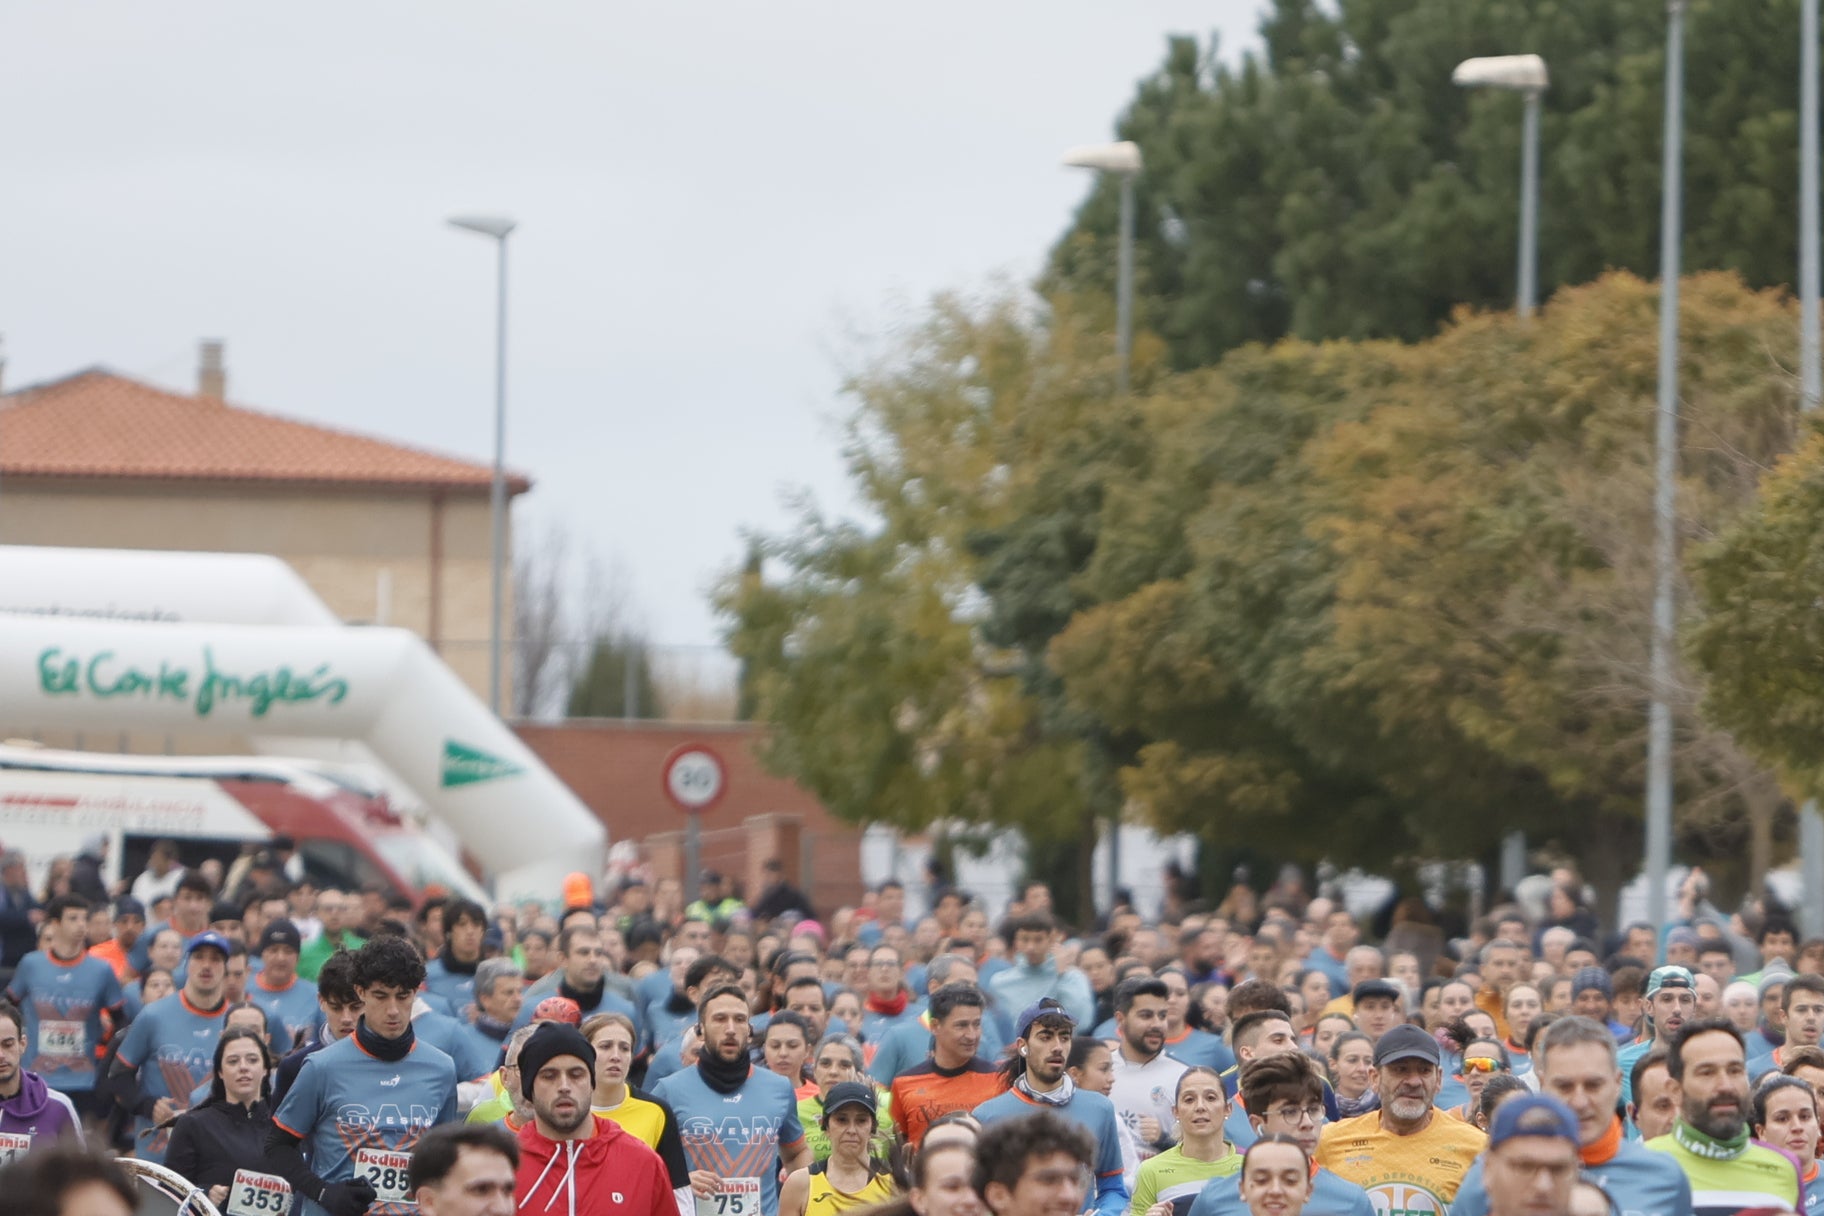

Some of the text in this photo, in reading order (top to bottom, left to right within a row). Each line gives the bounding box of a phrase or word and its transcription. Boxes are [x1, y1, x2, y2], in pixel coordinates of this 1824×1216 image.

[37, 643, 348, 716] El Corte Inglés
[359, 1150, 410, 1170] bedun
[367, 1166, 411, 1192] 285
[241, 1187, 284, 1212] 353
[714, 1195, 744, 1215] 75
